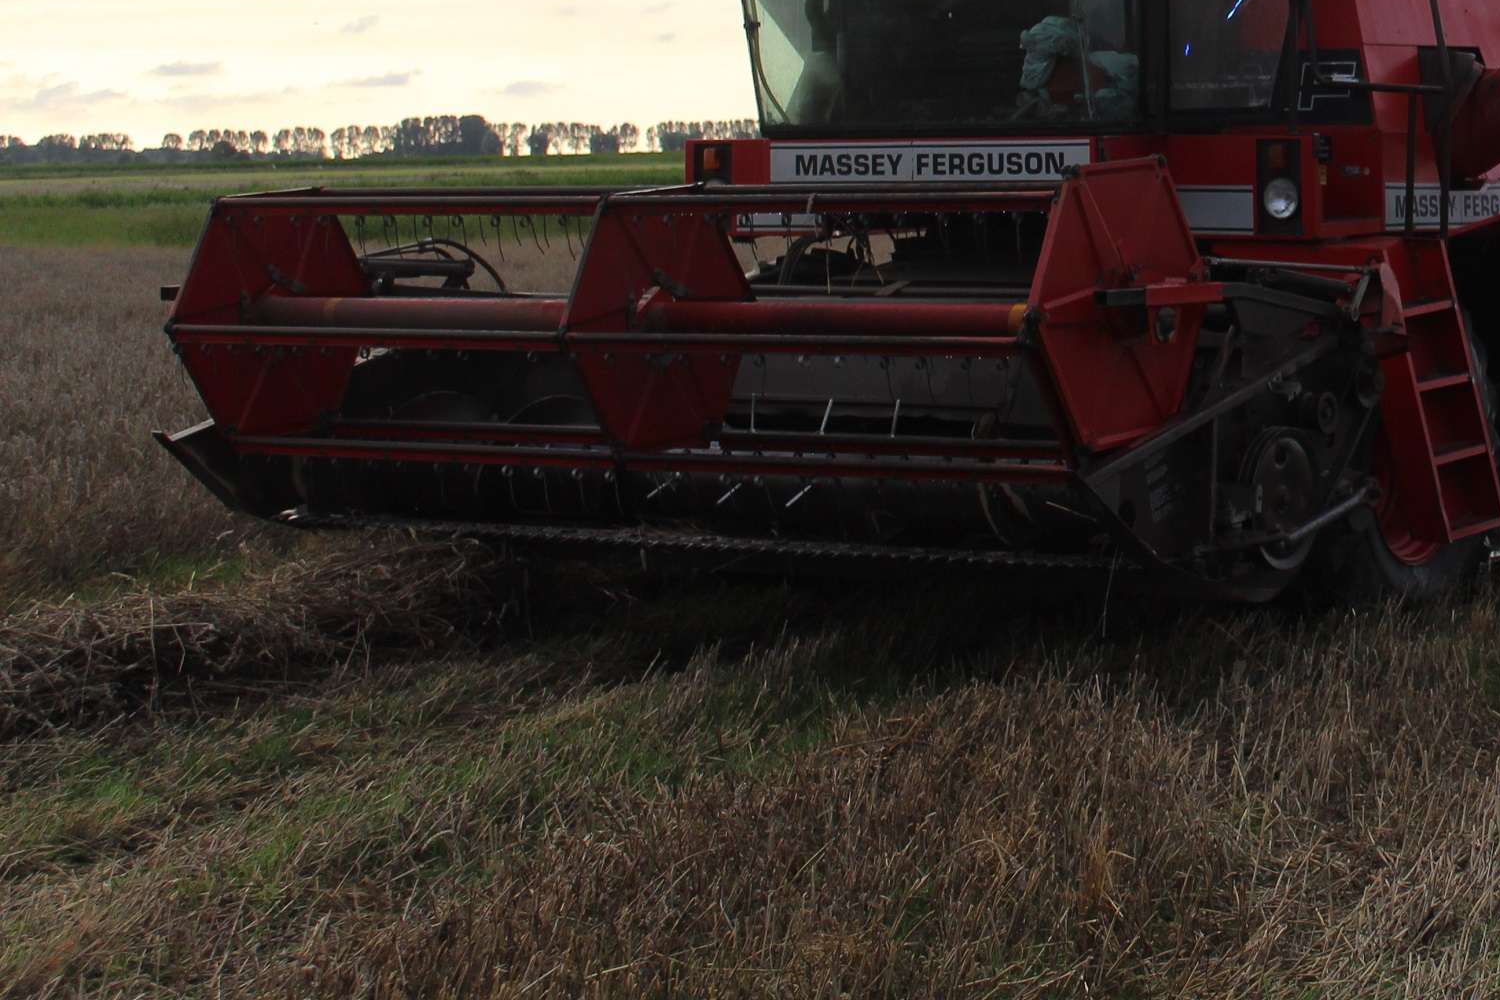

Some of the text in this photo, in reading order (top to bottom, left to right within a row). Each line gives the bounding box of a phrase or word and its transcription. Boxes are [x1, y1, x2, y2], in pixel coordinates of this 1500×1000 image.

[795, 152, 1065, 175] MASSEY FERGUSON
[1395, 195, 1456, 217] MASSY
